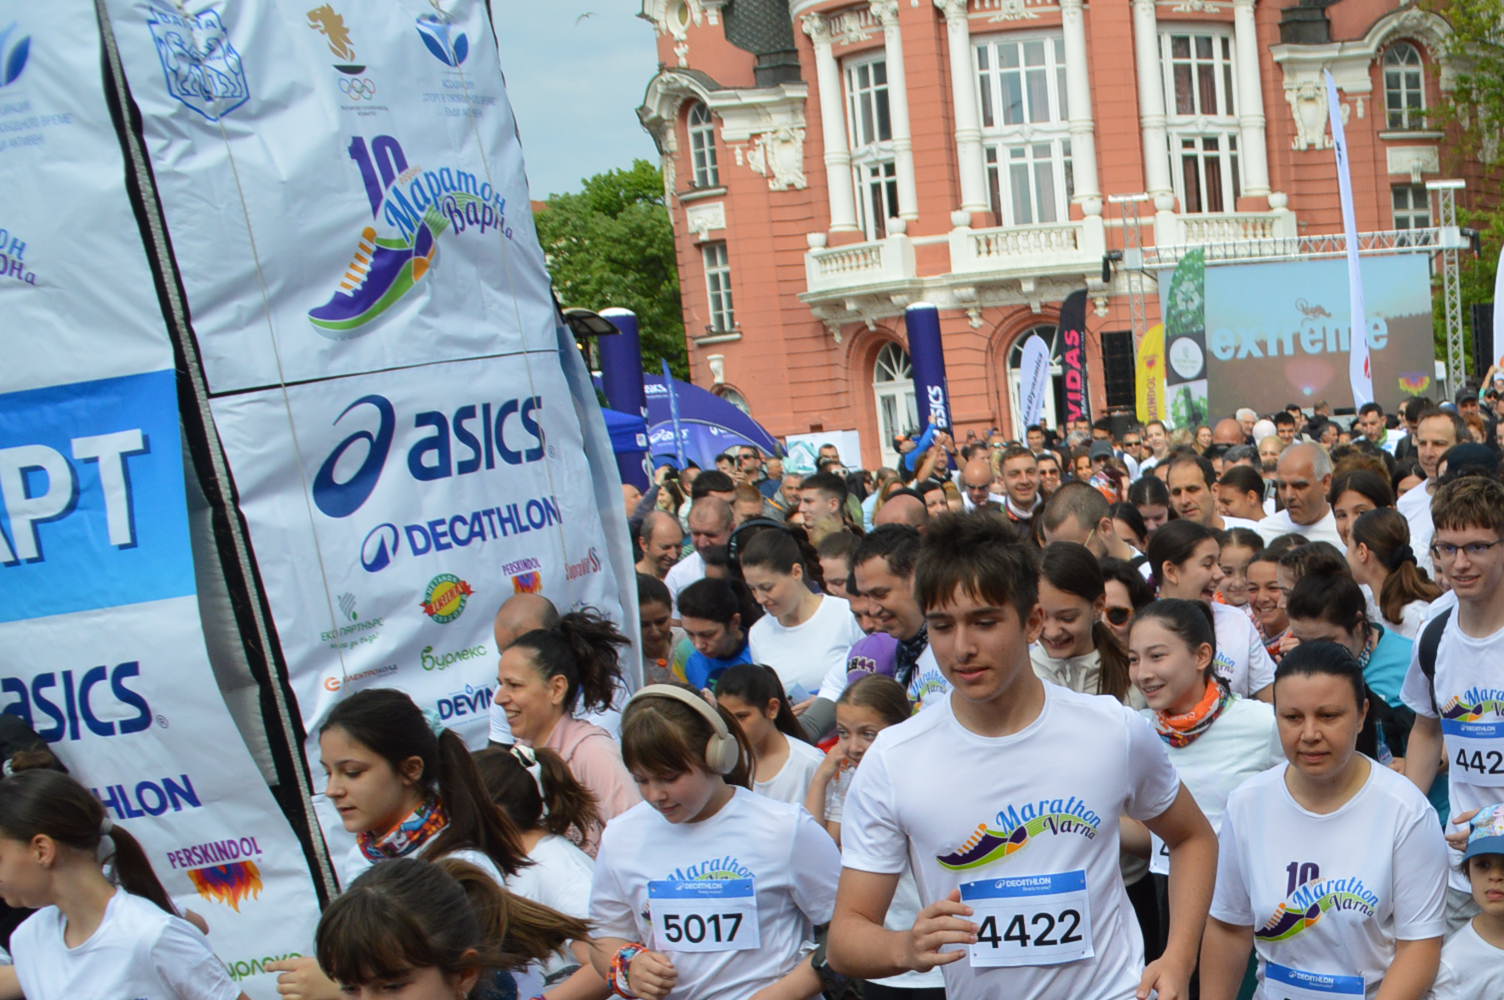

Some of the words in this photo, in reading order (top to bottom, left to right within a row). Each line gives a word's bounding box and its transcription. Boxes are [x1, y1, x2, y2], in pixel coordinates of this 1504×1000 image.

[384, 167, 506, 244] Маратон
[442, 195, 513, 241] Варна
[408, 396, 546, 482] asics
[0, 427, 150, 566] РТ
[403, 496, 562, 557] DECATHLON
[1, 661, 152, 743] asics
[92, 774, 202, 820] HLON
[996, 796, 1102, 834] Marathon
[1043, 815, 1097, 840] Varna
[166, 836, 263, 870] PERSKINDOL
[1004, 877, 1052, 888] DECATHLON
[1293, 876, 1380, 912] Marathon
[1329, 893, 1375, 918] Varna
[663, 913, 743, 943] 5017
[977, 909, 1083, 949] 4422
